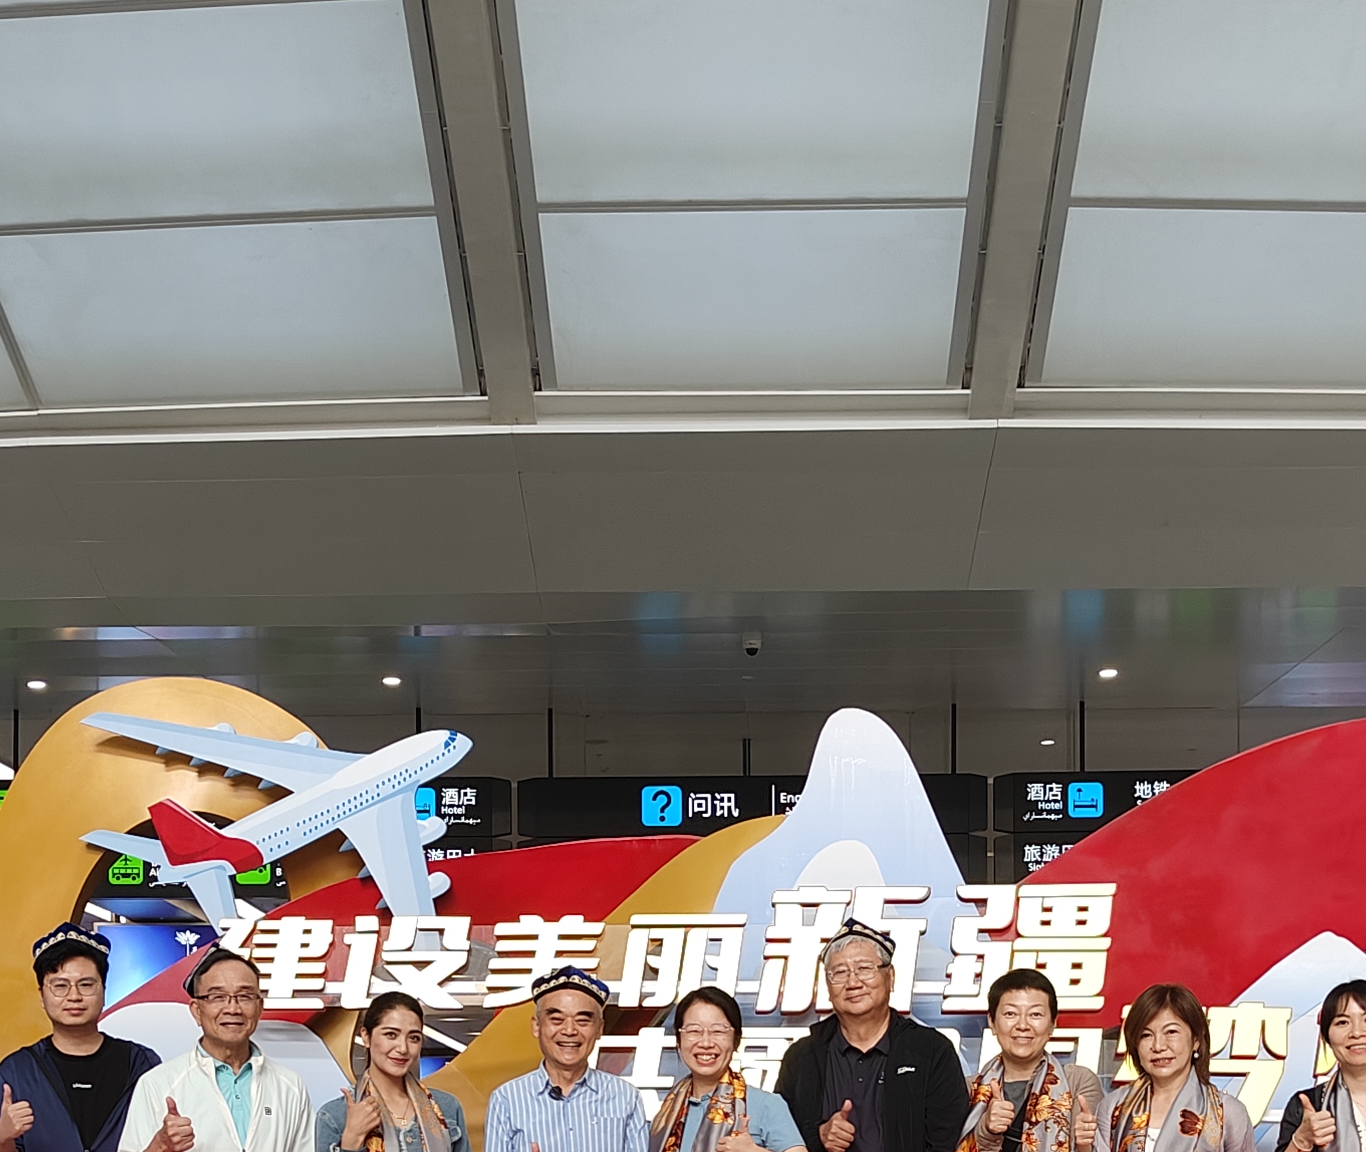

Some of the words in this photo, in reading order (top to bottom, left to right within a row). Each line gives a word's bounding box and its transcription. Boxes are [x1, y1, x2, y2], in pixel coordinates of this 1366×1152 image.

[441, 787, 477, 806] 酒店
[1026, 783, 1063, 801] 酒店
[440, 806, 466, 815] Hotel
[688, 792, 740, 818] 问讯
[1038, 801, 1063, 810] Hotel
[219, 883, 1118, 1014] 建设美丽新疆
